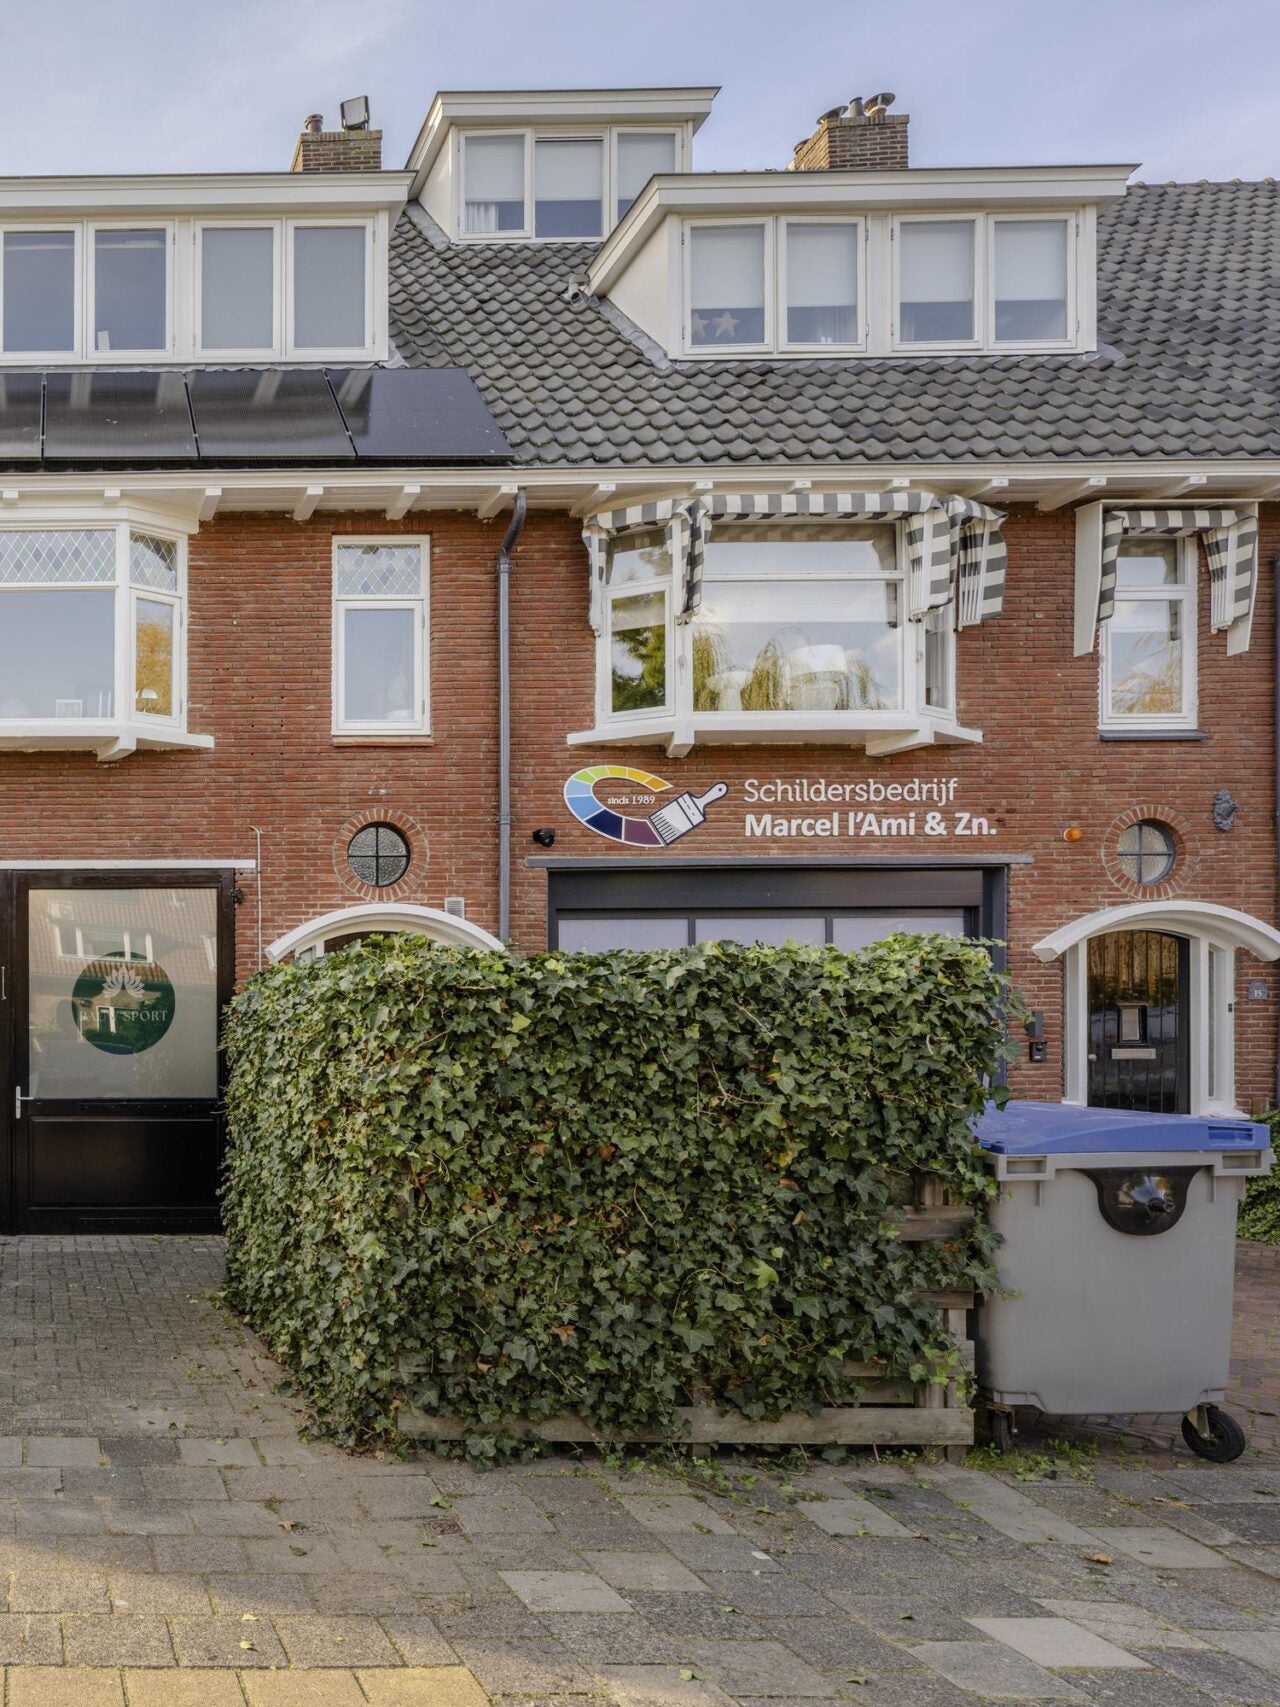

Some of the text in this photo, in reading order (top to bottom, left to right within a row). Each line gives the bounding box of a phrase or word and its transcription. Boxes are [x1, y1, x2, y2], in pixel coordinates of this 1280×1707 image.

[607, 795, 656, 805] sinds 1989
[744, 778, 959, 806] Schildersbedrijf
[744, 812, 839, 837] Marcel
[923, 812, 948, 836] &
[954, 812, 998, 836] Zn.
[122, 1009, 168, 1022] SPORT
